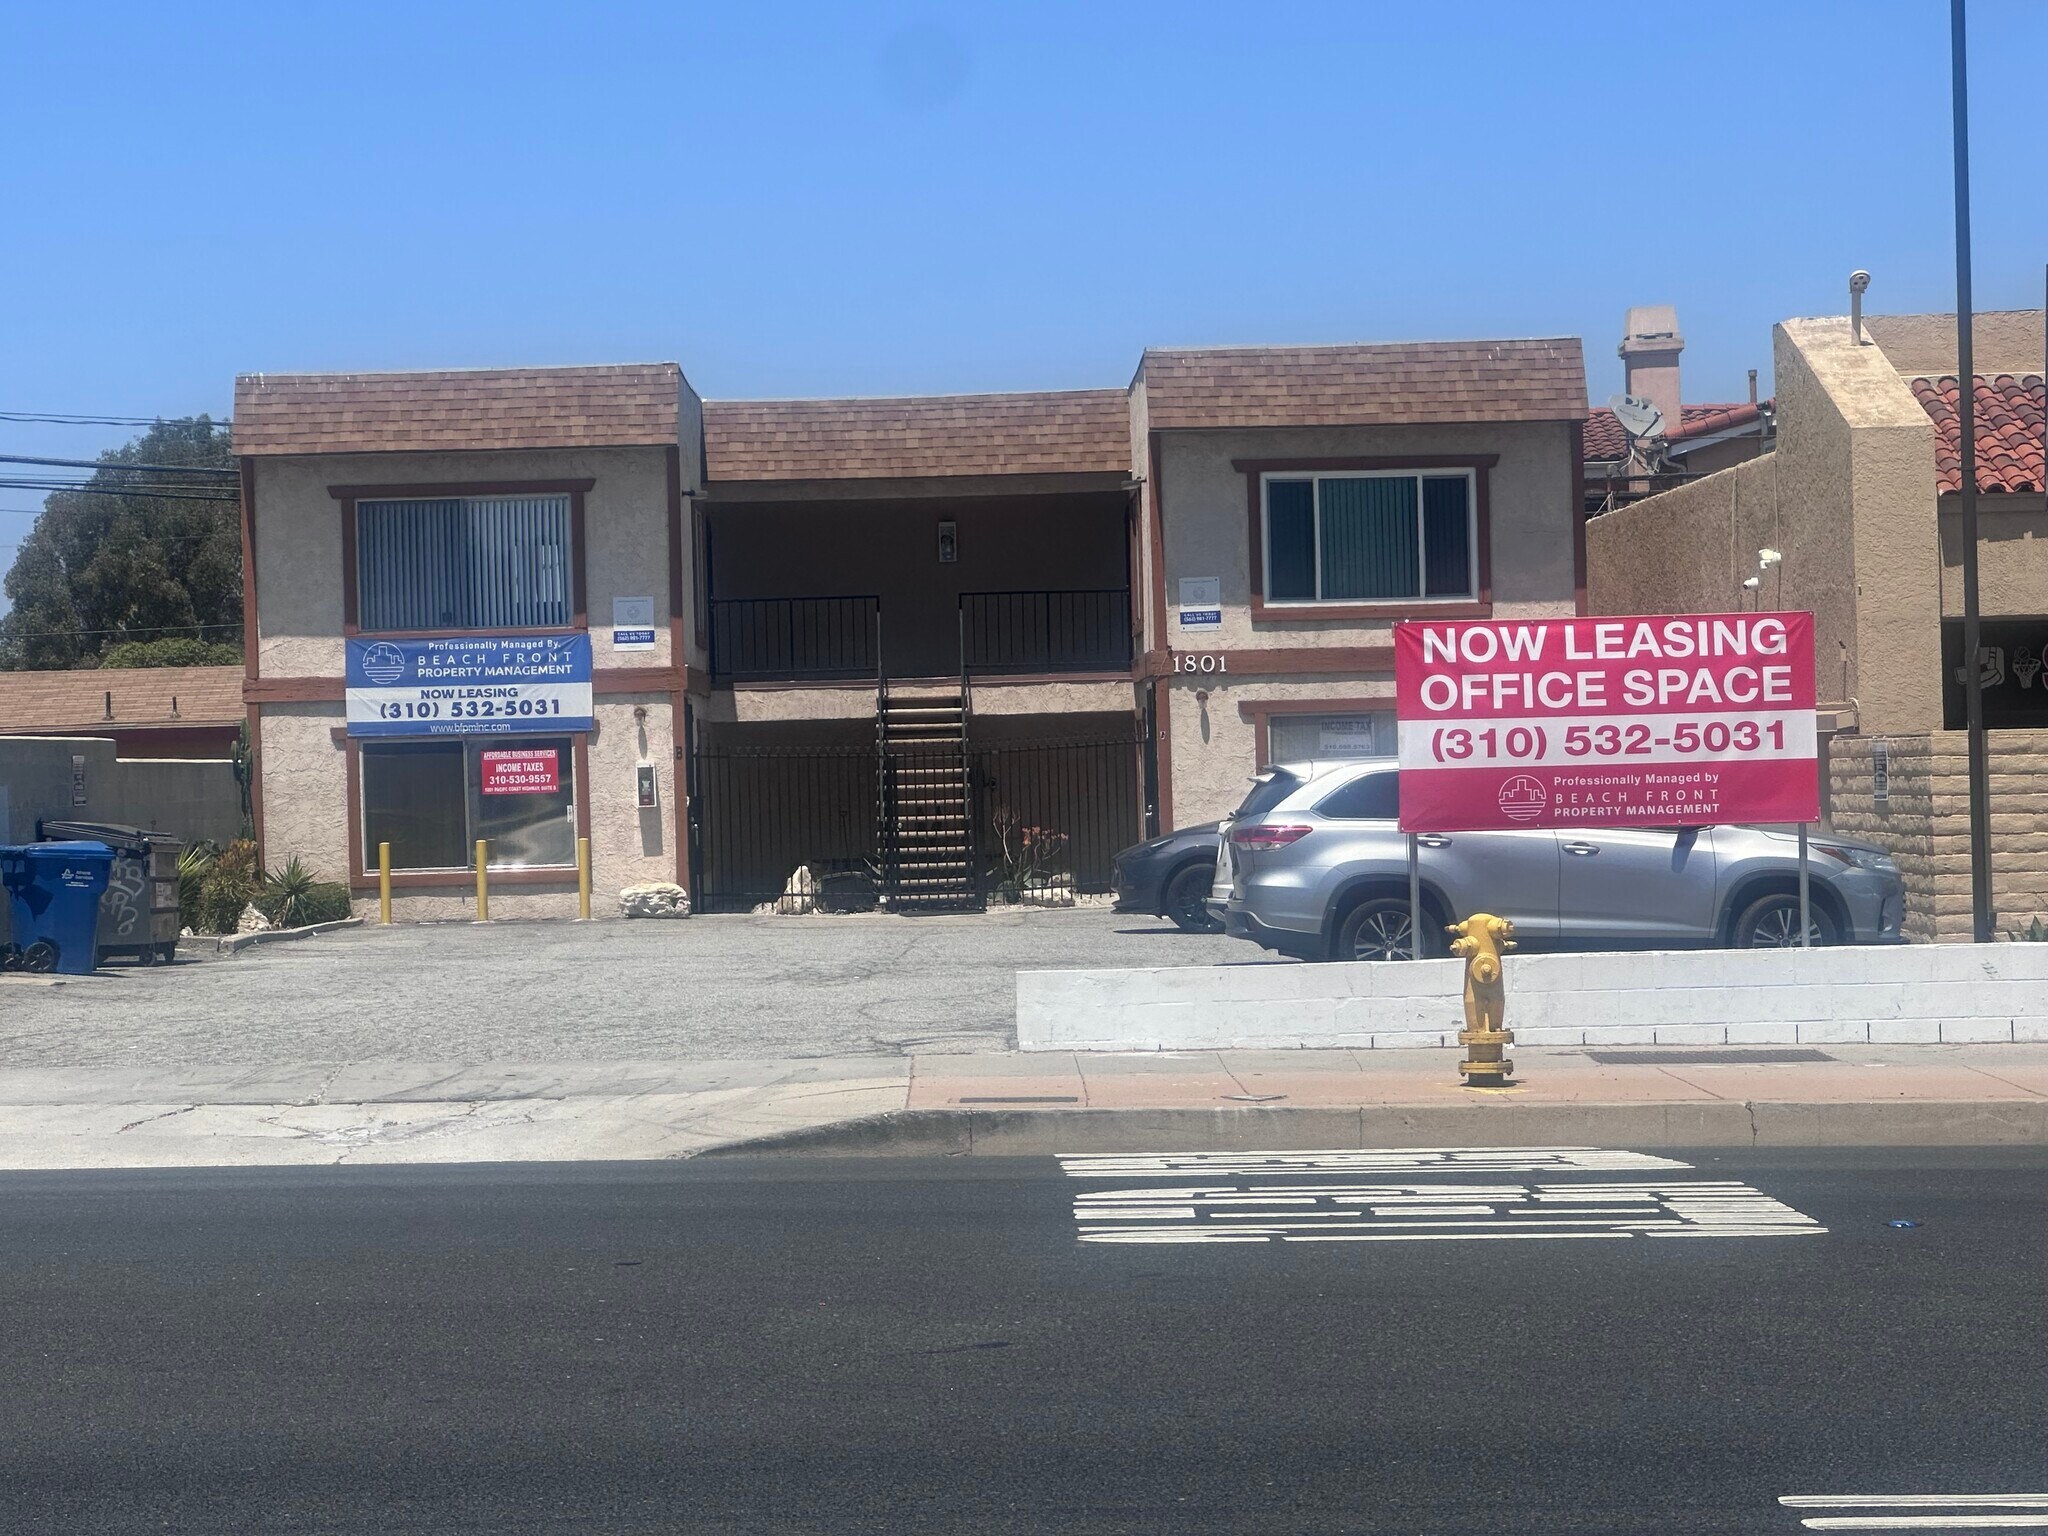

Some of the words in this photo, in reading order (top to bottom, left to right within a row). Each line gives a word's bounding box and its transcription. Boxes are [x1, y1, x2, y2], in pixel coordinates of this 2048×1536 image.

[428, 640, 497, 652] Professionally
[501, 640, 544, 650] Managed
[1423, 625, 1547, 664] NOW
[1565, 618, 1788, 660] LEASING
[418, 654, 486, 666] BEACH
[503, 652, 572, 664] FRONT
[1174, 655, 1226, 672] 1801
[417, 667, 482, 678] PROPERTY
[485, 664, 572, 676] MANAGEMENT
[420, 688, 454, 700] NOW
[458, 687, 518, 698] LEASING
[1420, 669, 1607, 712] OFFICE
[1622, 665, 1793, 707] SPACE
[380, 702, 440, 720] (310)
[451, 699, 560, 717] 532-5031
[430, 722, 511, 734] www.bfpminc.com
[1431, 726, 1548, 762] (310)
[1564, 719, 1785, 756] 532-5031
[676, 746, 682, 760] B
[496, 763, 521, 772] INCOME
[523, 762, 544, 772] TAXES
[489, 774, 551, 784] 310-530-9557
[1554, 772, 1641, 788] Professionally
[1645, 772, 1702, 786] Managed
[1705, 772, 1720, 784] by
[1556, 792, 1628, 804] BEACH
[1646, 789, 1719, 802] FRONT
[1554, 805, 1622, 818] PROPERTY
[1626, 803, 1720, 816] MANAGEMENT
